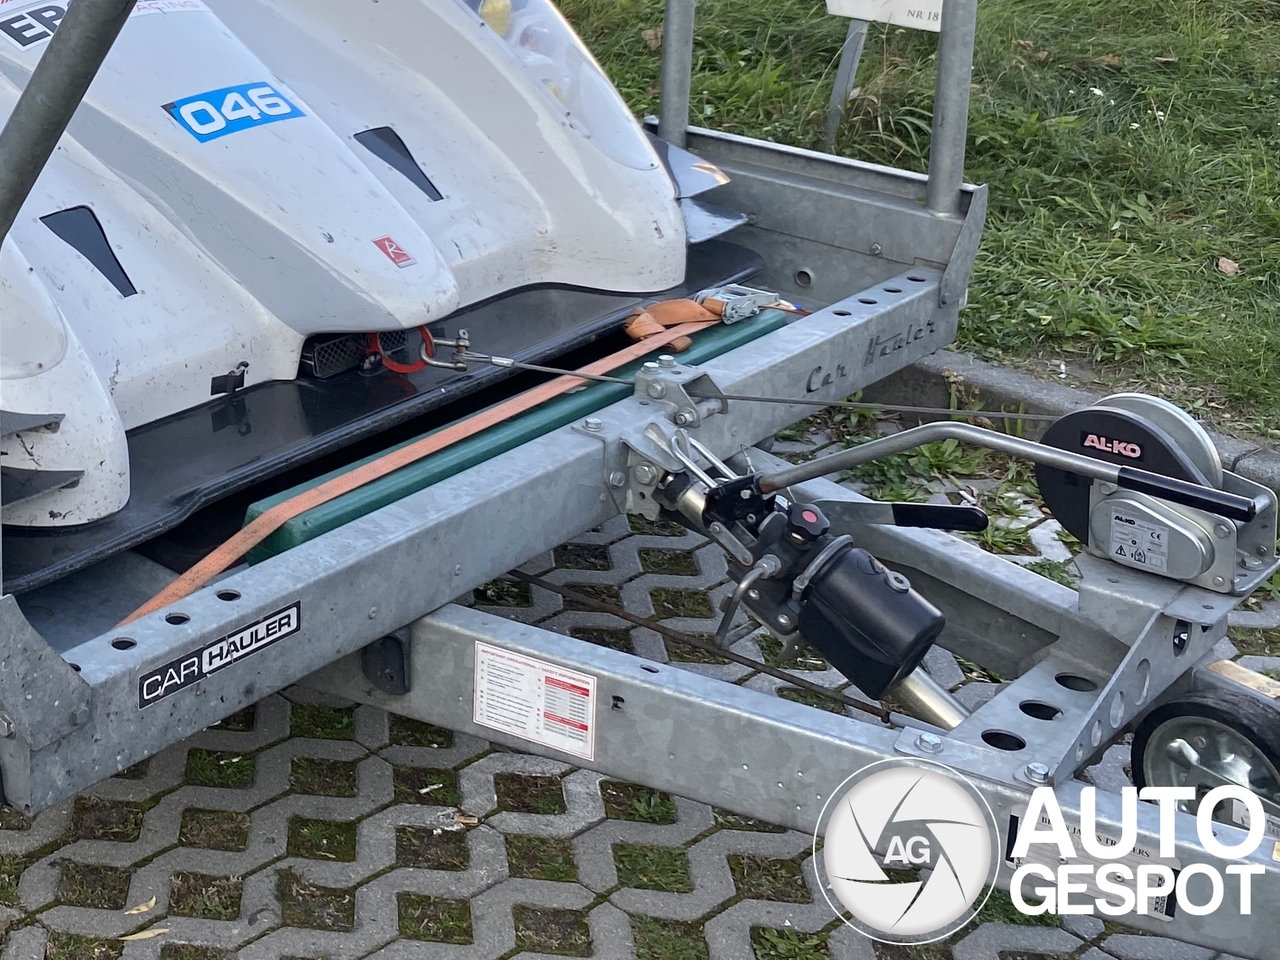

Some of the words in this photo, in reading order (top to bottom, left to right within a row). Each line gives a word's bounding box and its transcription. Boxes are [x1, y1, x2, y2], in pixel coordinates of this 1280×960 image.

[907, 9, 923, 20] NR
[926, 11, 939, 22] 18
[178, 86, 293, 135] 046
[806, 364, 847, 393] Car
[143, 656, 199, 700] CAR
[208, 613, 292, 667] HAULER
